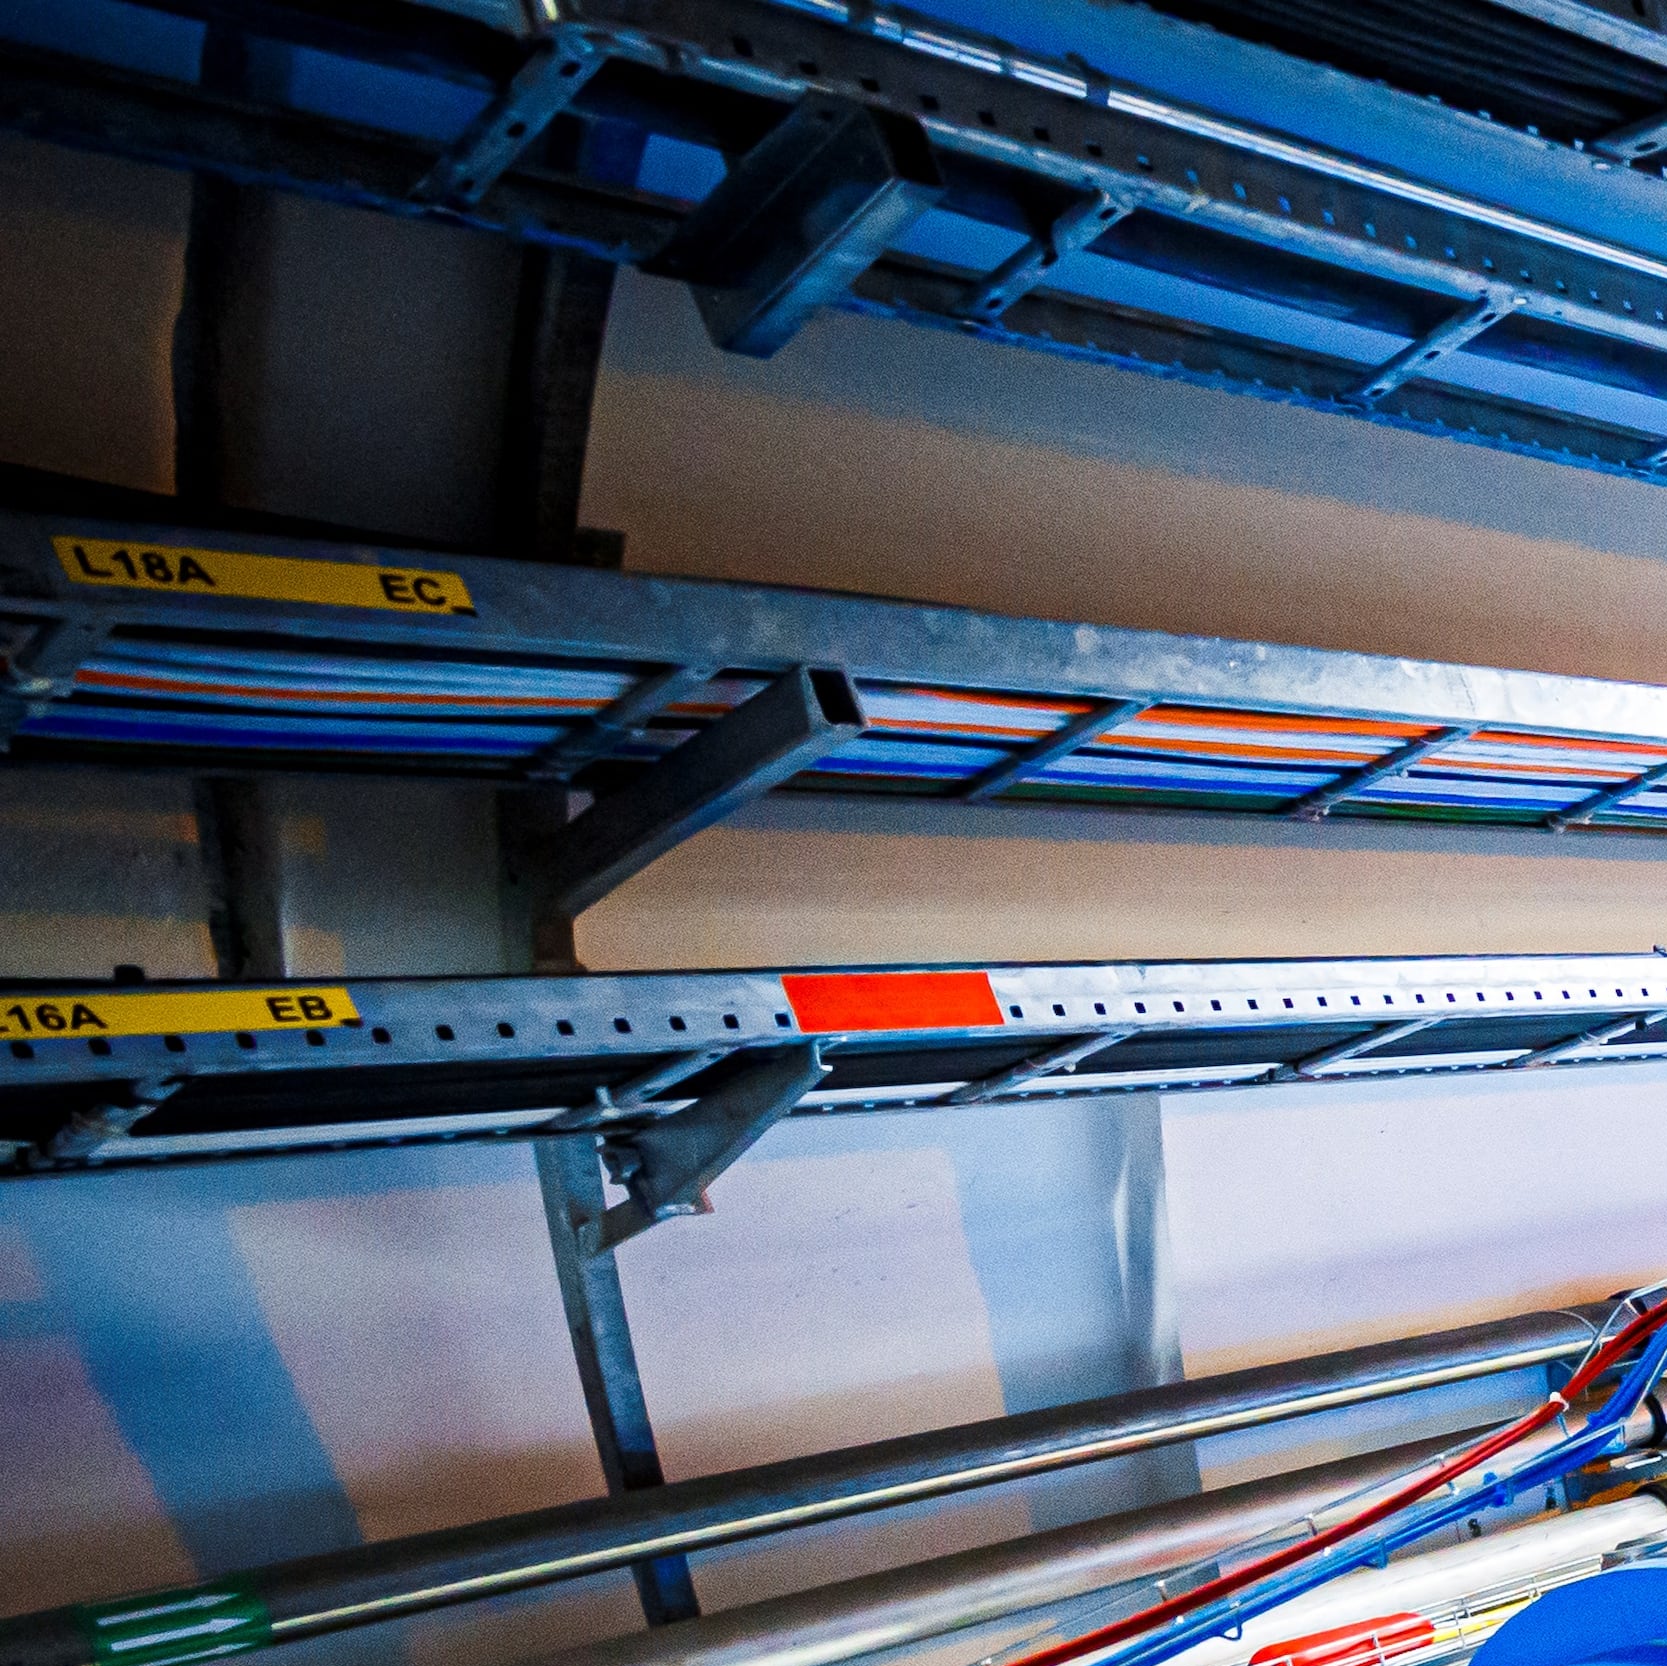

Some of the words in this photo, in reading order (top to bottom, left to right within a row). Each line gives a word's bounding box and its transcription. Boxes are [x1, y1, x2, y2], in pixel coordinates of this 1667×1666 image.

[72, 545, 217, 587] L18A
[378, 572, 446, 605] EC
[0, 1002, 108, 1033] 16A
[265, 995, 334, 1023] EB
